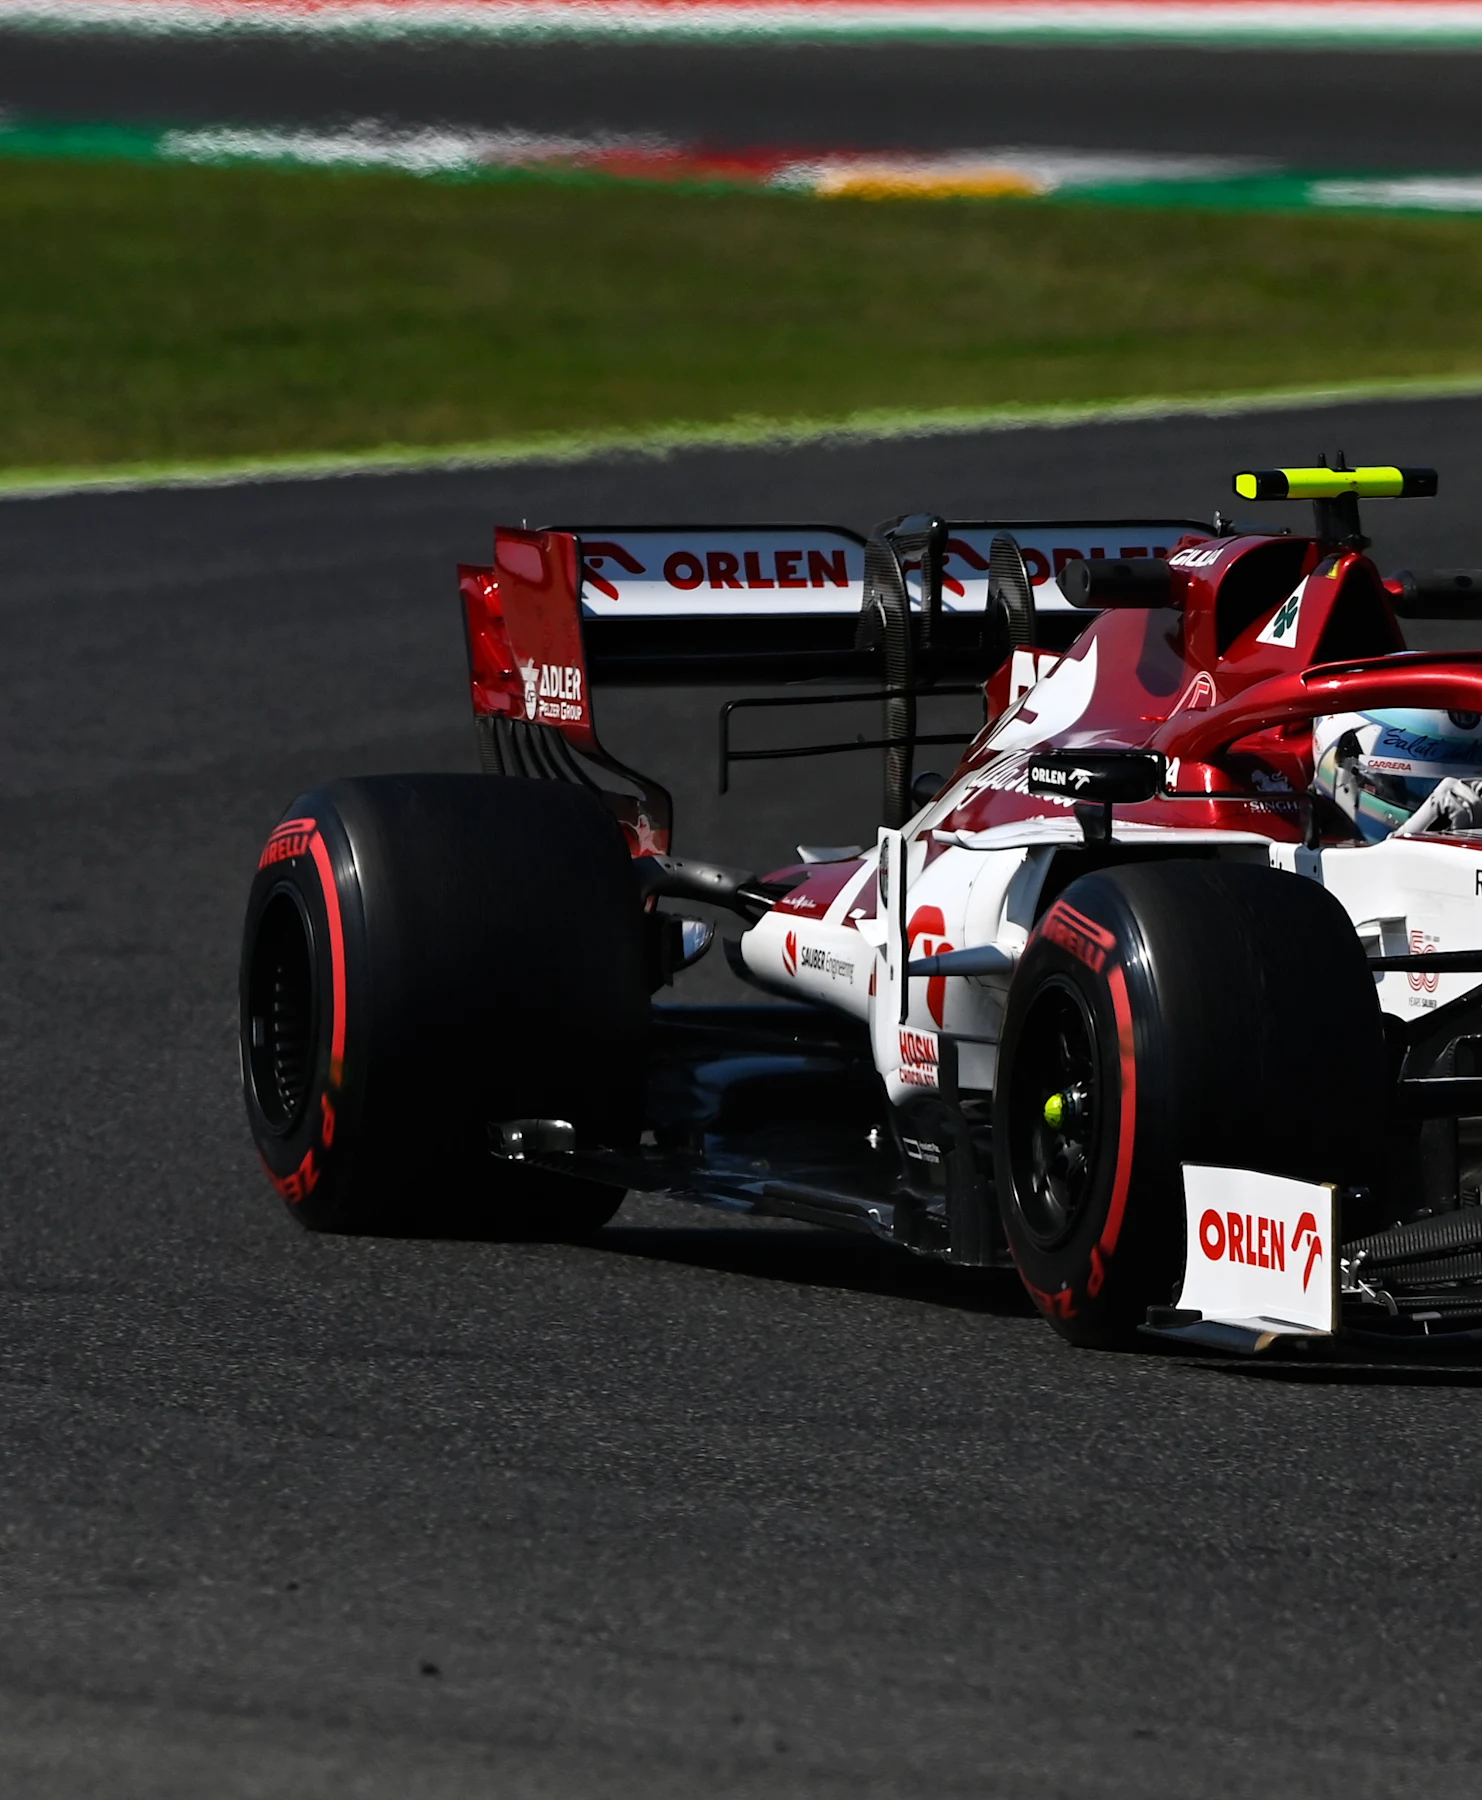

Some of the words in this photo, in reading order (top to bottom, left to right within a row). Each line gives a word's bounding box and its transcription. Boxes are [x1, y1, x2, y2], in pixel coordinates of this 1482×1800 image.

[663, 549, 849, 590] ORLEN
[540, 664, 581, 701] ADLER
[1032, 766, 1067, 786] ORLEN
[1367, 759, 1412, 771] CARRERA
[1249, 800, 1300, 811] SINGH
[258, 817, 317, 872] PIRELLI
[801, 946, 826, 970] SAUBER
[1199, 1208, 1286, 1272] ORLEN
